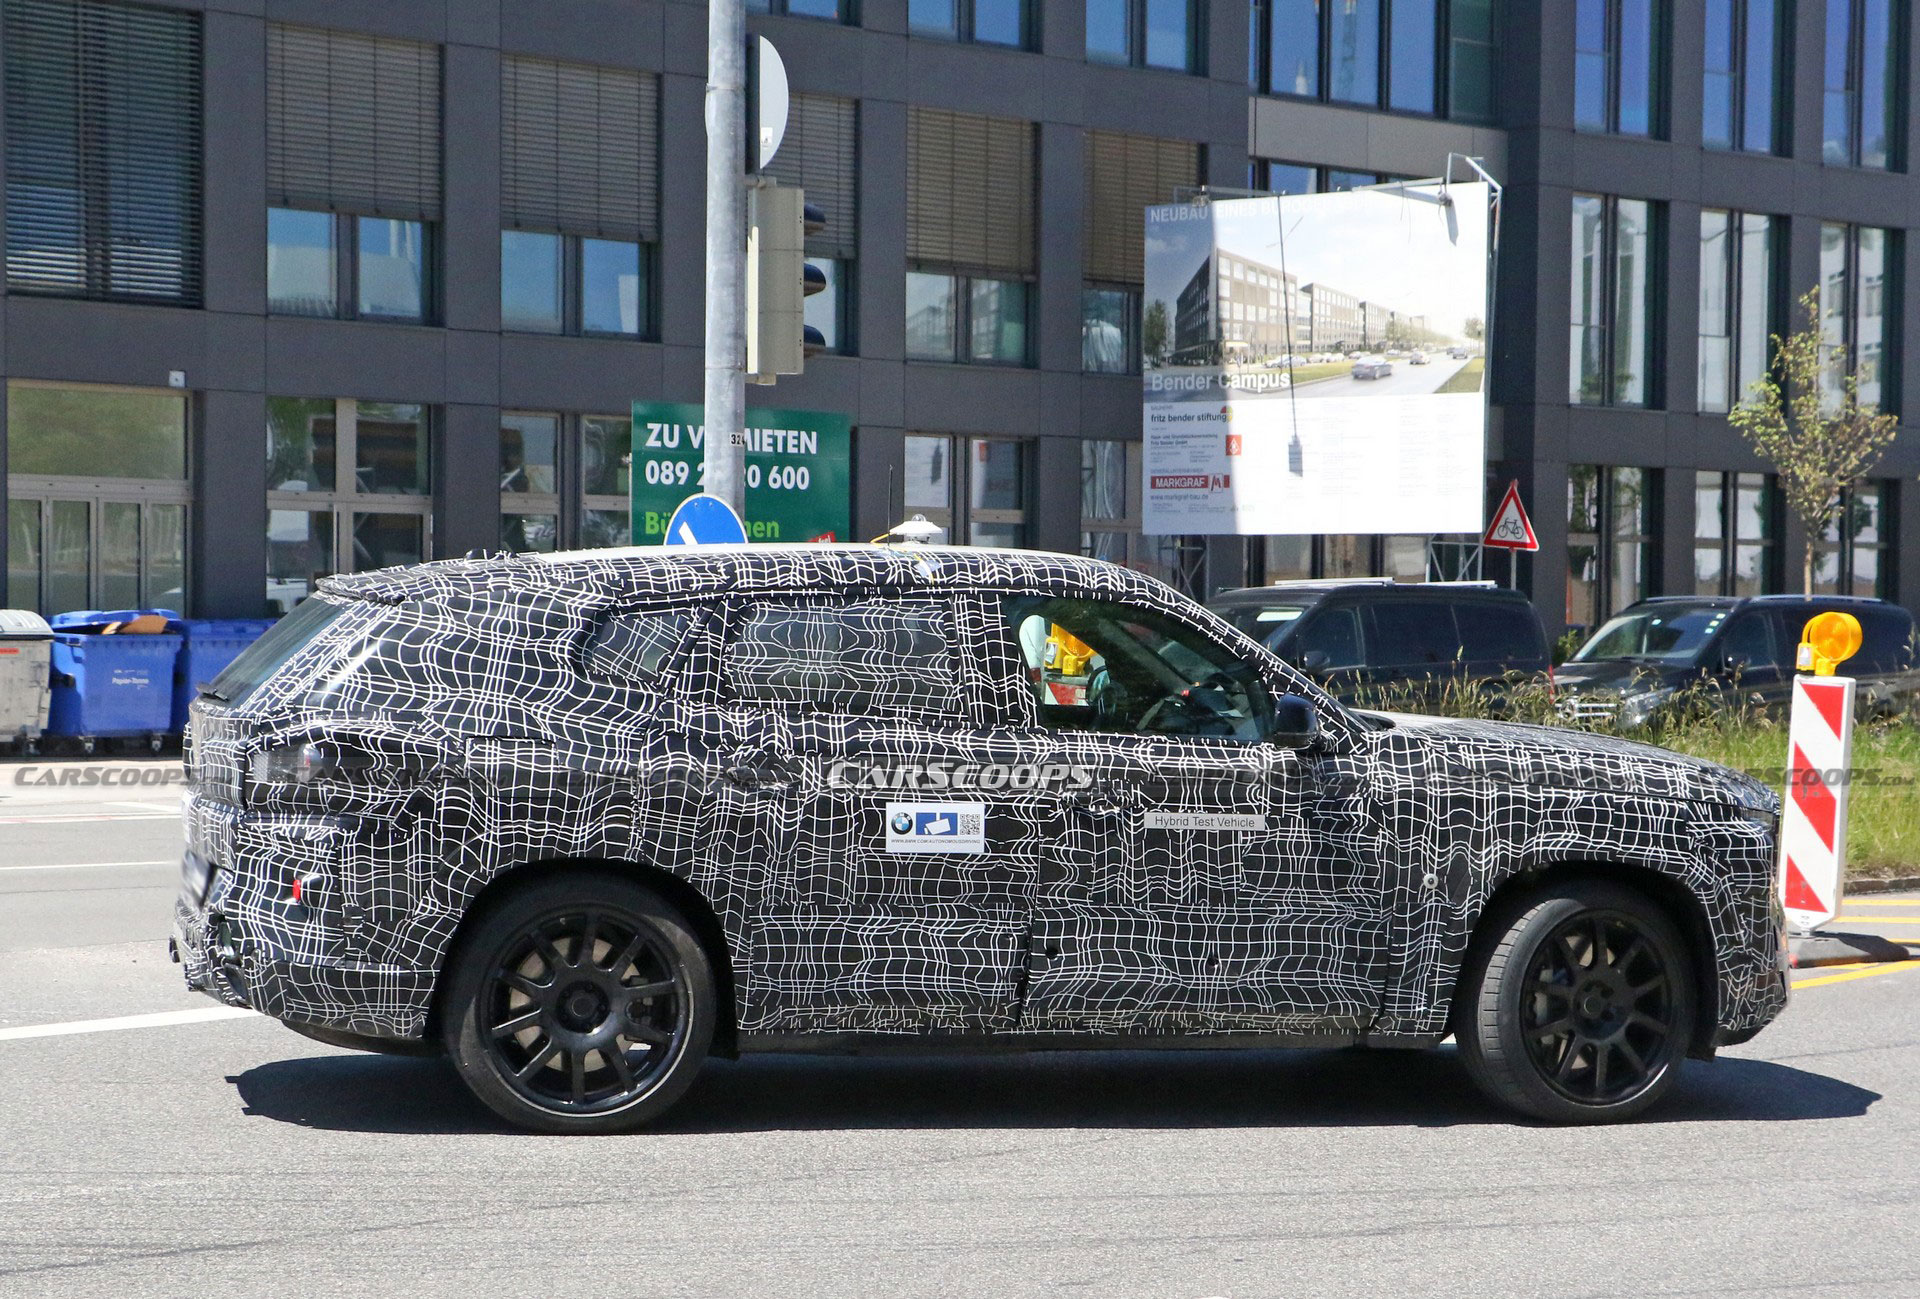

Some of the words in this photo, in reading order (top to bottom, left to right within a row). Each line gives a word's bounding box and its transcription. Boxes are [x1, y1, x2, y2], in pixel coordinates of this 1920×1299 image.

[1150, 206, 1208, 222] NEUBAU
[1152, 373, 1213, 391] Bender
[1218, 372, 1290, 393] Campus
[1151, 414, 1166, 423] fritz
[1168, 413, 1194, 422] bender
[1197, 412, 1227, 423] stiftung
[645, 423, 680, 448] ZU
[645, 460, 689, 485] 089
[768, 466, 810, 490] 600
[1156, 477, 1205, 488] MARKGRAF
[1155, 815, 1189, 828] Hybrid
[1193, 816, 1214, 827] Test
[1217, 817, 1255, 828] Vehicle
